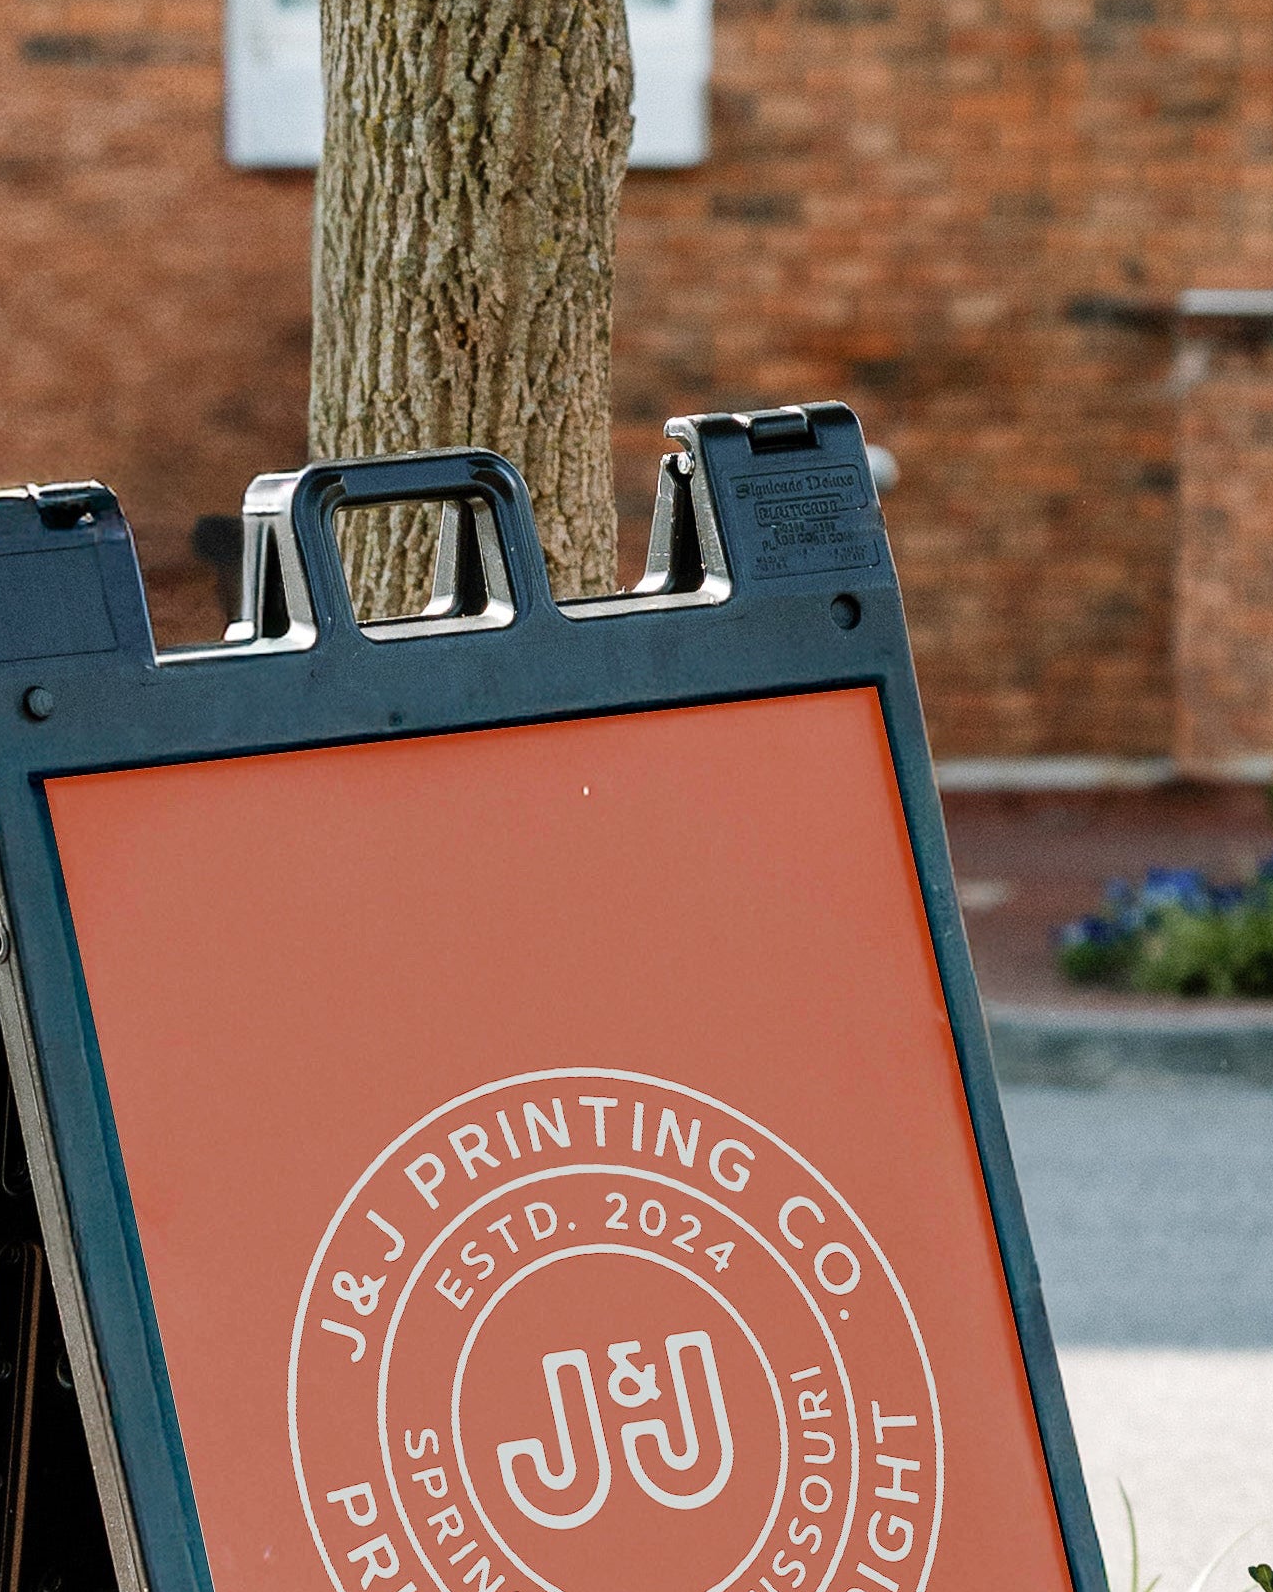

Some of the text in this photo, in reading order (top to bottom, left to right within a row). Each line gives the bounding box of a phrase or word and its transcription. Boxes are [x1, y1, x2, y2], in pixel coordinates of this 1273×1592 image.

[319, 1094, 862, 1364] J&J PRINTING CO.
[433, 1191, 737, 1312] ESTD. 2024
[495, 1329, 736, 1531] J&J
